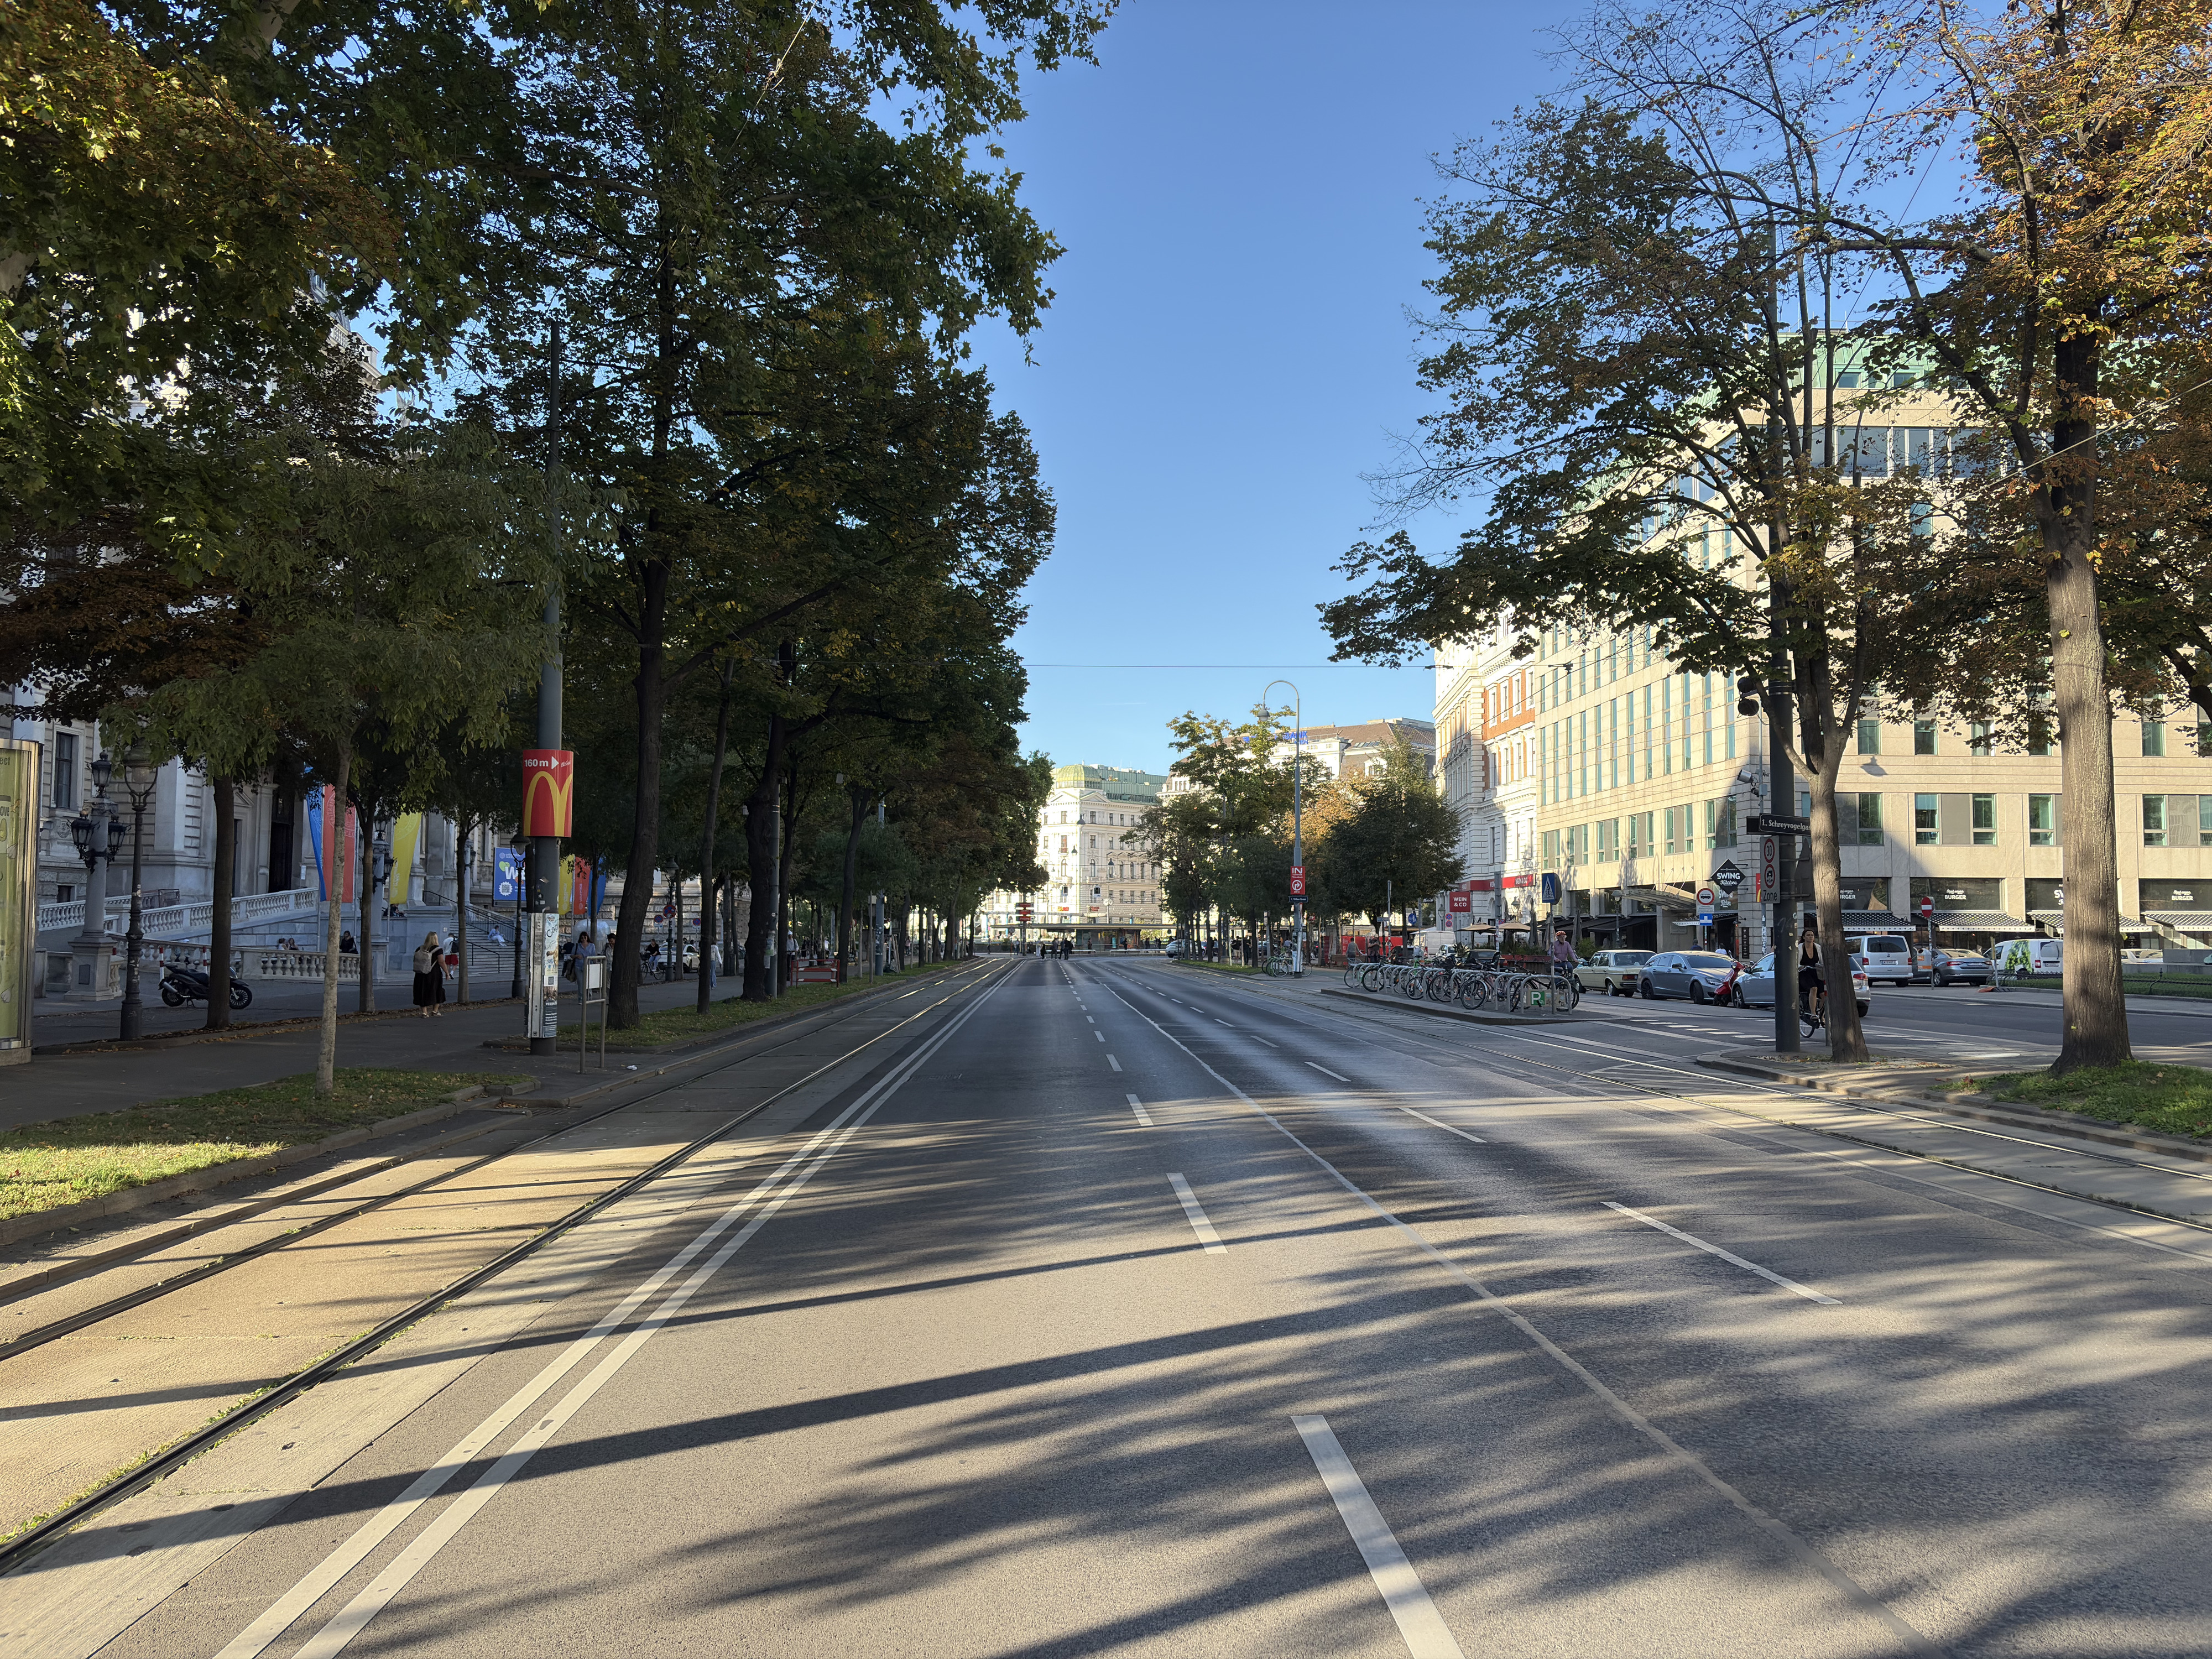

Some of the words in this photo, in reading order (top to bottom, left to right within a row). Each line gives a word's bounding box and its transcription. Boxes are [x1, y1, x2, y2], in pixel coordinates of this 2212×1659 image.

[524, 759, 538, 767] 160
[1766, 845, 1772, 857] 30
[1763, 890, 1777, 901] Zone
[1531, 992, 1541, 1004] P
